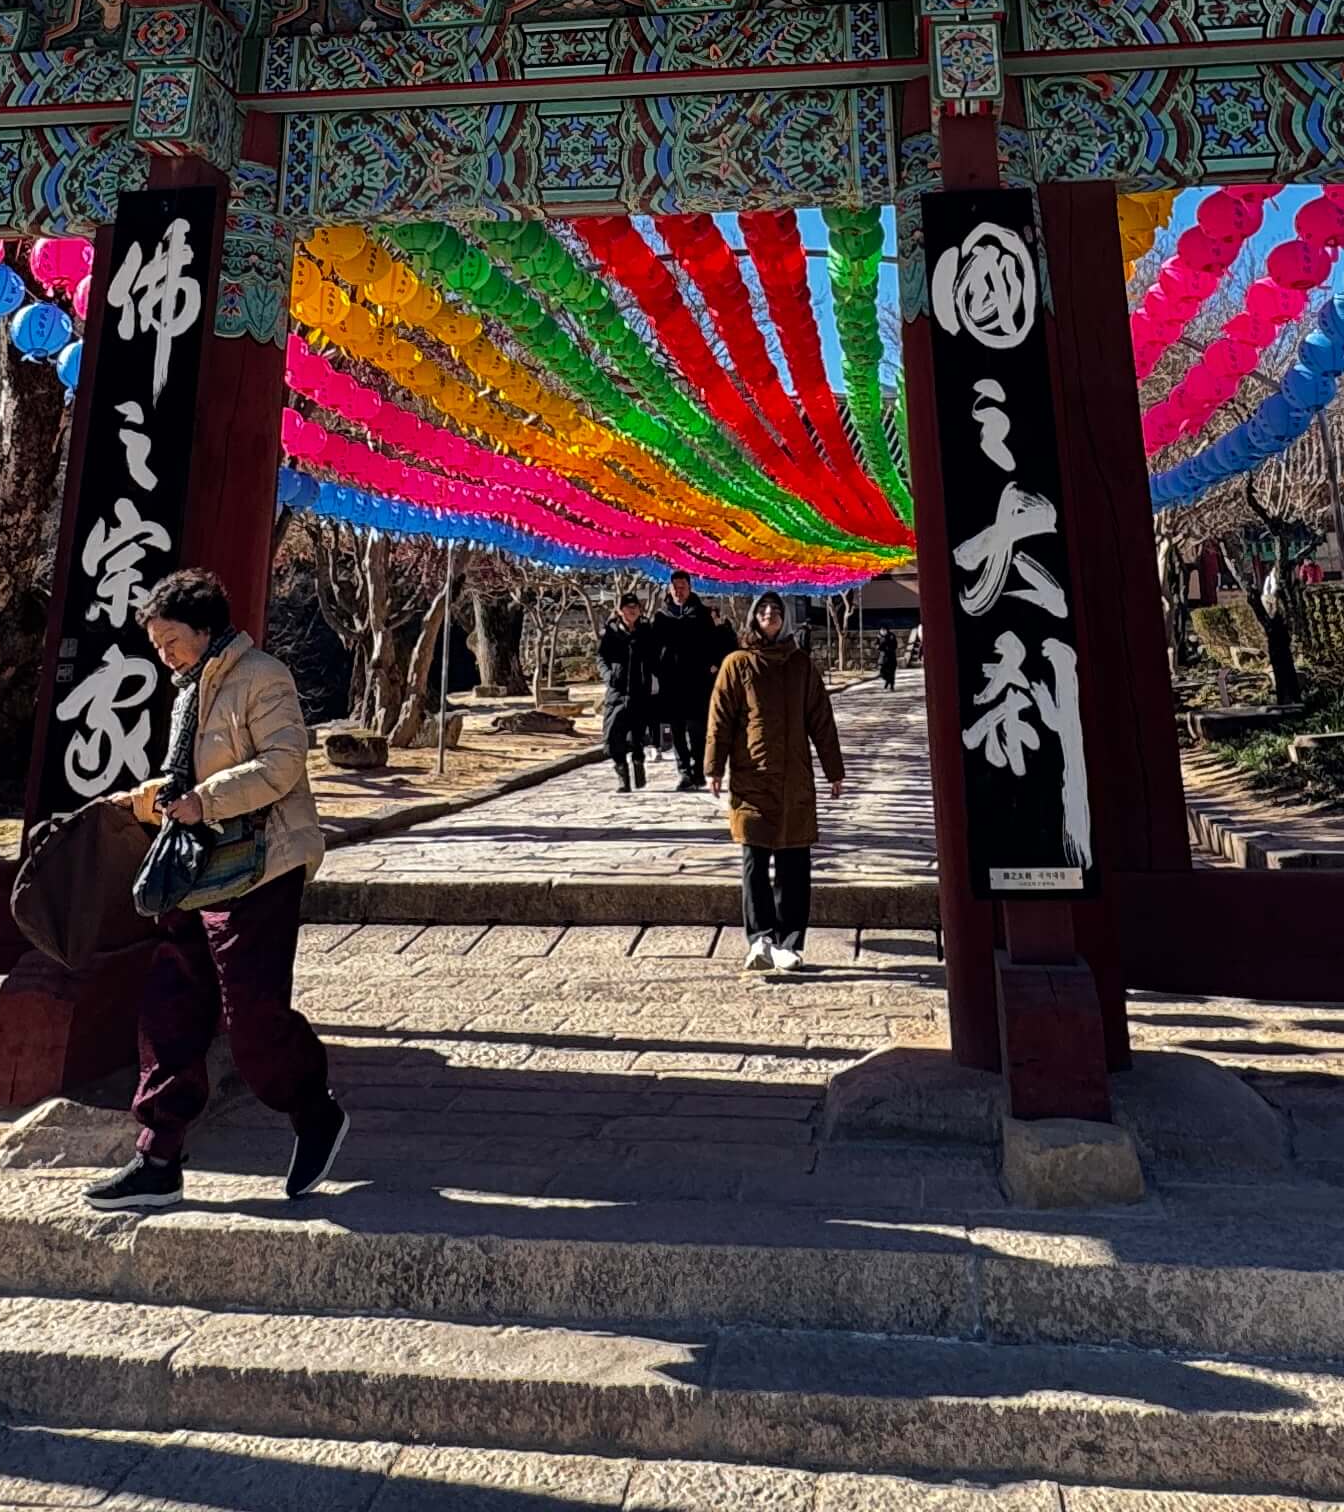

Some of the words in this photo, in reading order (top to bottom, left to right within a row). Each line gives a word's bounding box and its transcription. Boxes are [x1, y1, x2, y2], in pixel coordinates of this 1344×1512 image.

[56, 217, 203, 798] 佛之宗家
[931, 220, 1094, 870] 國之大刹
